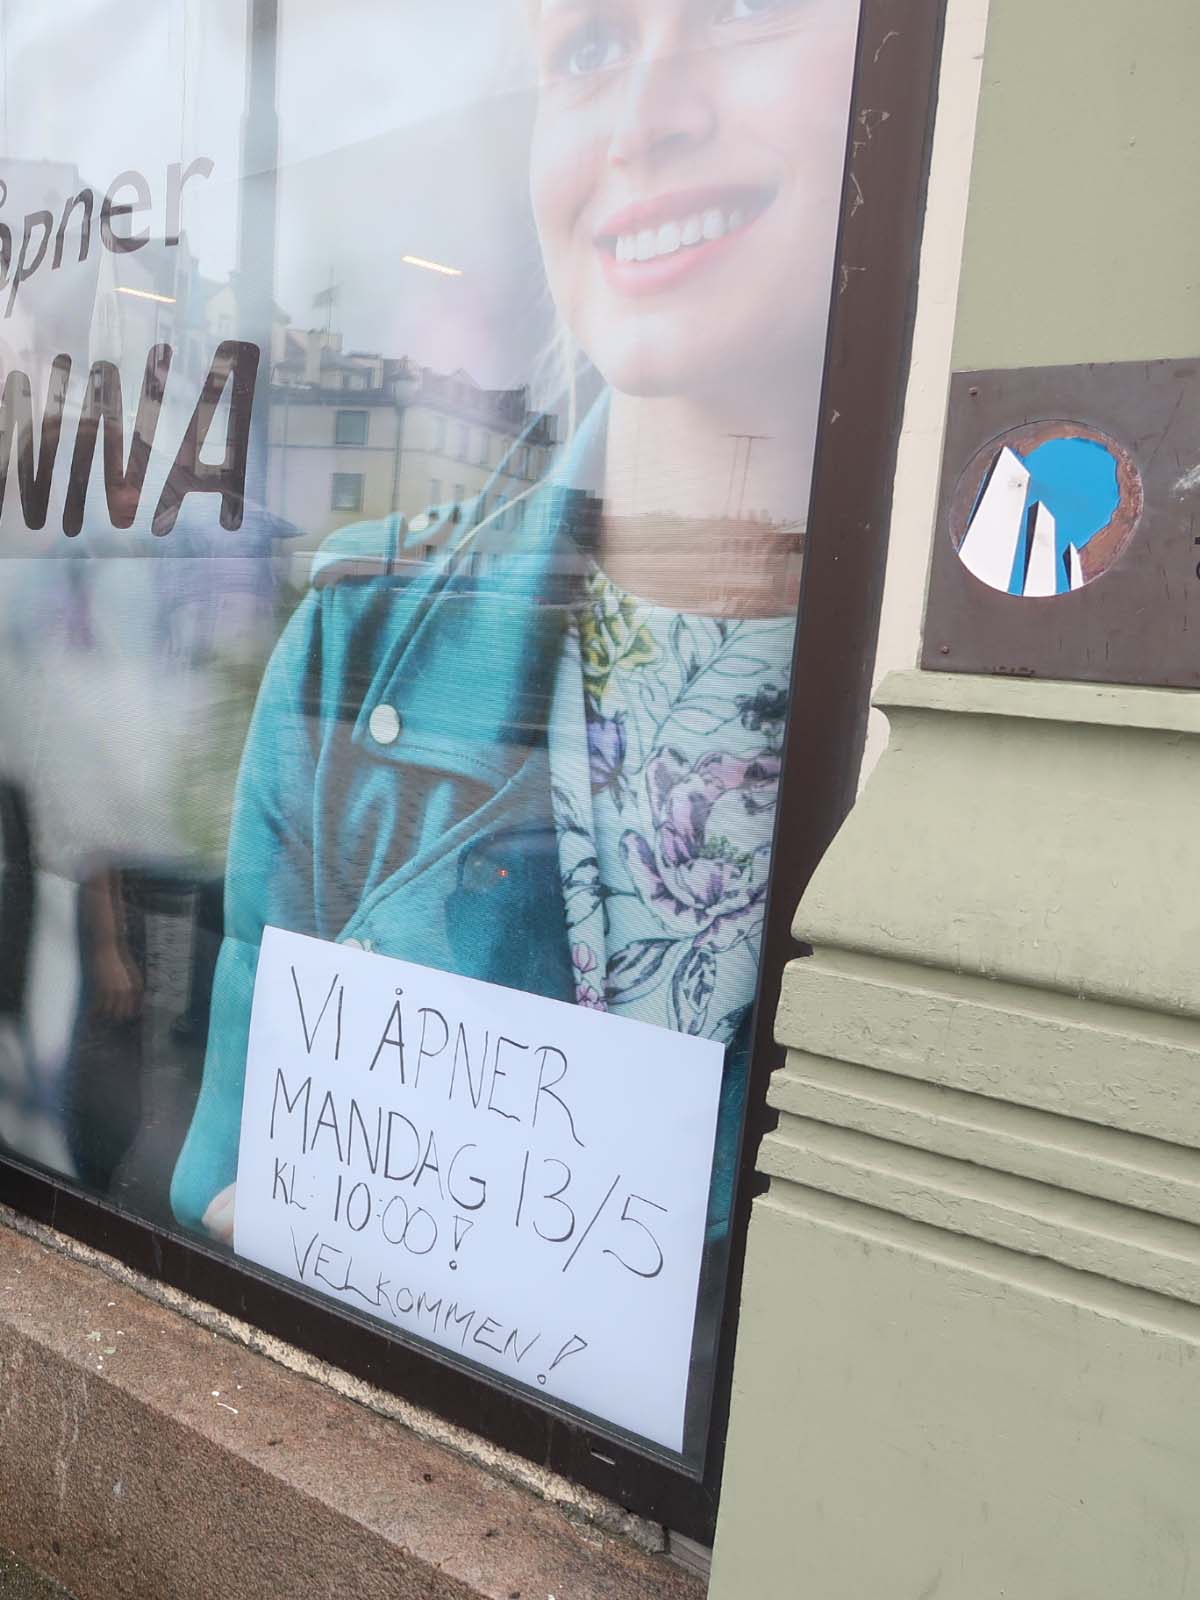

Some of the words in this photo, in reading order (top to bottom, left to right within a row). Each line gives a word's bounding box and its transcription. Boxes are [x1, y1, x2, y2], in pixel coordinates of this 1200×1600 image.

[291, 966, 344, 1061] VI
[369, 987, 585, 1147] ÅPNER
[269, 1067, 487, 1211] MANDAG
[516, 1150, 668, 1278] 13/5
